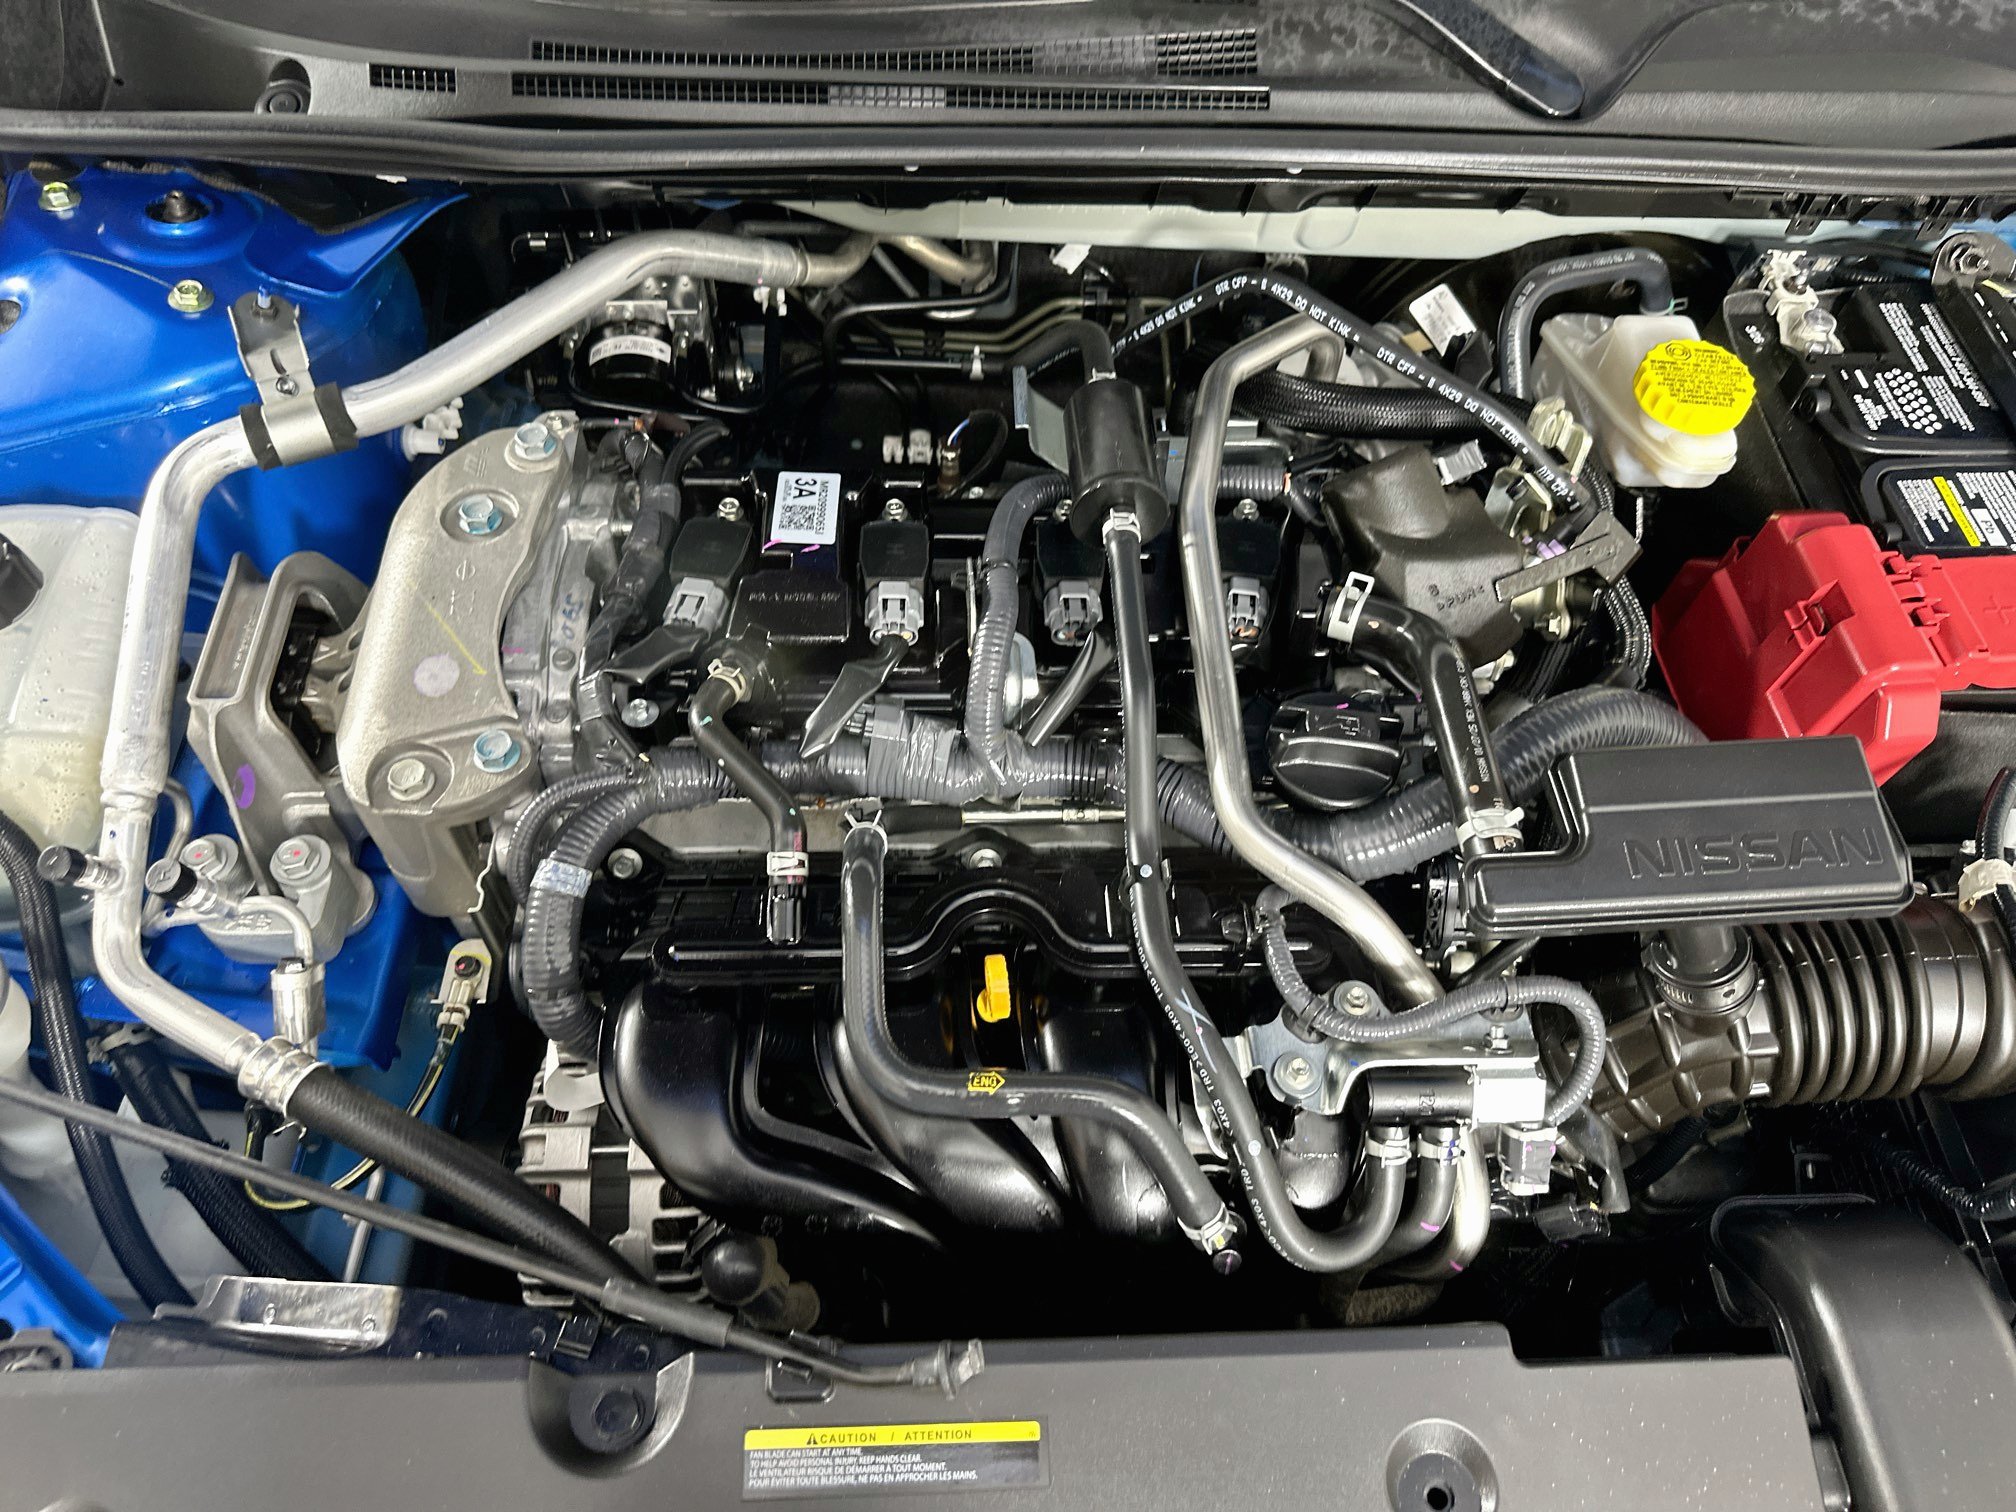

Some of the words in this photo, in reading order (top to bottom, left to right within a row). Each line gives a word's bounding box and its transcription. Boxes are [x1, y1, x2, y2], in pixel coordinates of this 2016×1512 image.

[1231, 275, 1248, 289] CFP
[1271, 282, 1293, 301] 4X29
[1294, 294, 1307, 312] DO
[1308, 304, 1327, 322] NOT
[1328, 316, 1352, 339] KINK
[1376, 347, 1396, 365] DTR
[1397, 358, 1416, 375] CFP
[1438, 383, 1463, 403] 4X29
[1464, 398, 1479, 413] DO
[1479, 408, 1500, 427] NOT
[1500, 424, 1525, 448] KINK
[793, 478, 818, 499] 3A
[1981, 520, 1995, 534] Pb
[1623, 825, 1885, 880] NISSAN
[973, 1077, 997, 1087] ENG
[820, 1432, 876, 1444] CAUTION
[904, 1430, 972, 1441] ATTENTION
[764, 1451, 785, 1459] BLADE
[786, 1450, 801, 1458] CAN
[802, 1449, 822, 1457] START
[751, 1460, 759, 1468] TO
[760, 1460, 777, 1468] HELP
[800, 1457, 833, 1467] PERSONAL
[859, 1456, 876, 1464] KEEP
[876, 1455, 899, 1464] HANDS
[749, 1469, 757, 1477] LE
[759, 1467, 806, 1477] VENTILATEUR
[834, 1466, 844, 1474] DE
[893, 1464, 911, 1472] TOUT
[749, 1478, 770, 1487] POUR
[797, 1476, 819, 1485] TOUTE
[859, 1475, 869, 1483] NE
[870, 1474, 883, 1483] PAS
[884, 1474, 894, 1482] EN
[895, 1472, 938, 1482] APPROCHER
[939, 1472, 952, 1480] LES
